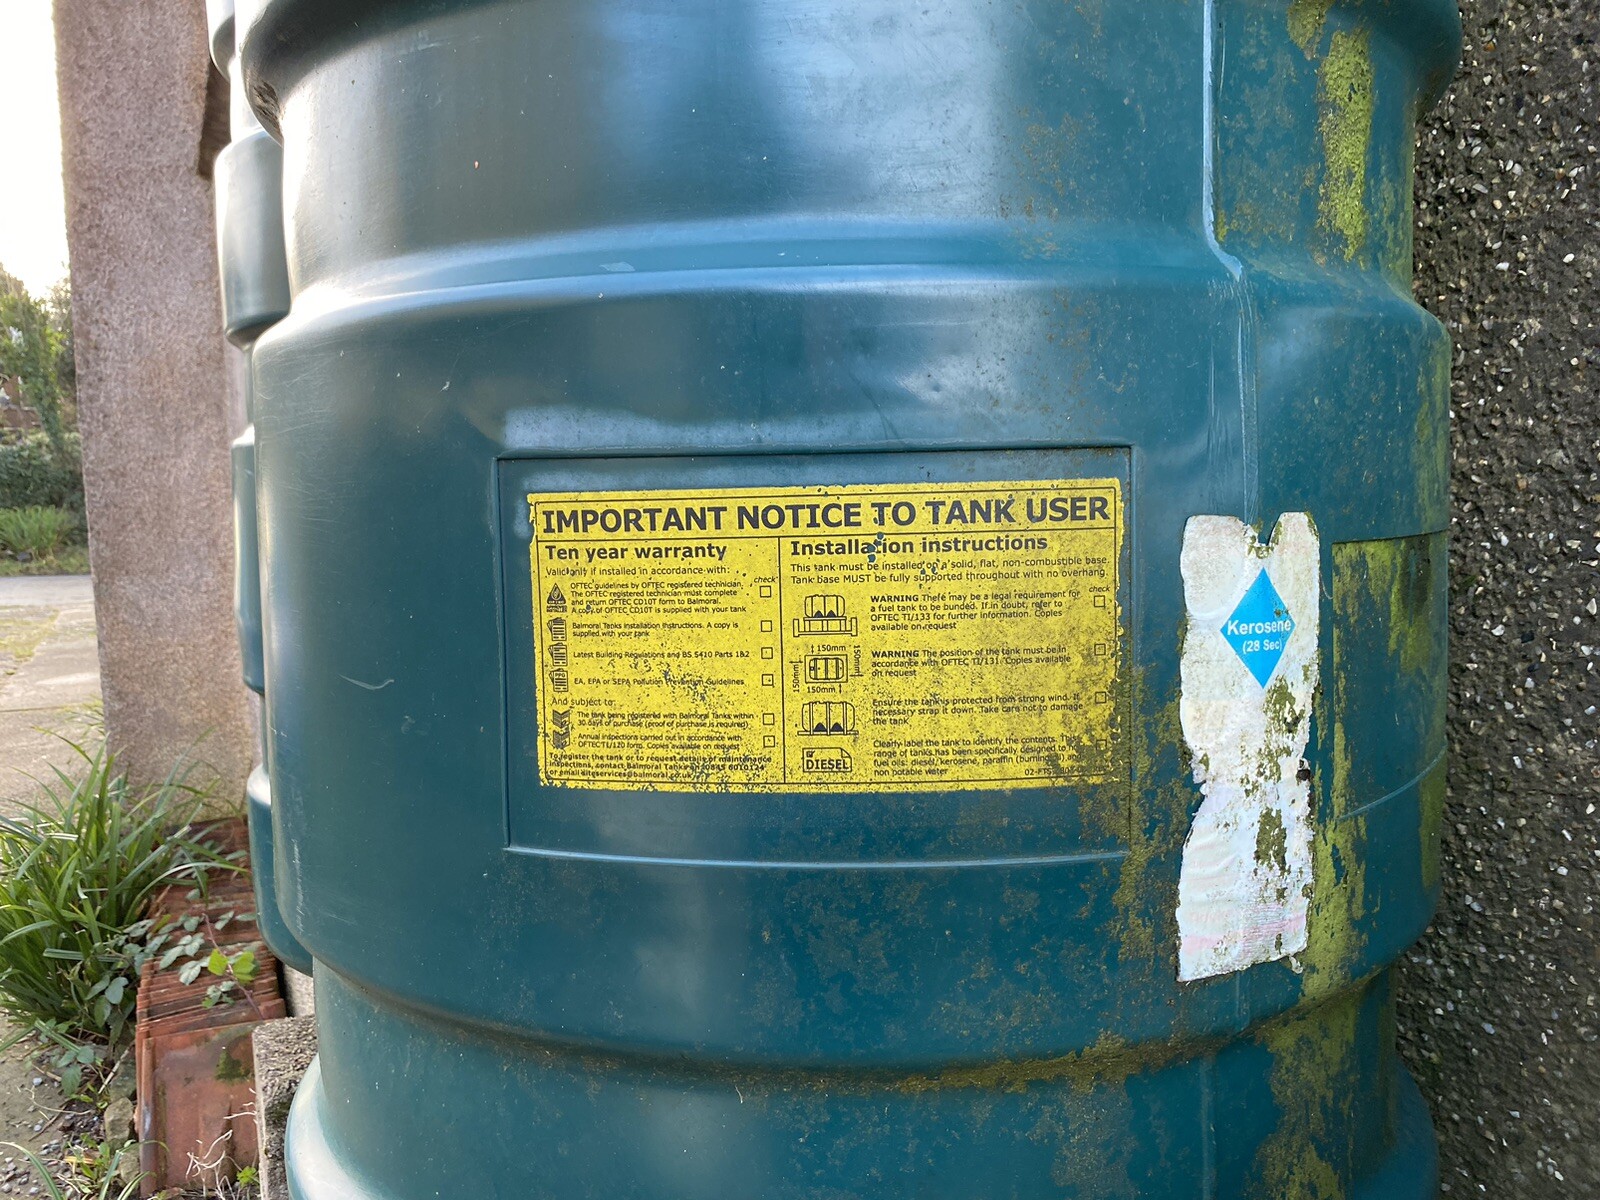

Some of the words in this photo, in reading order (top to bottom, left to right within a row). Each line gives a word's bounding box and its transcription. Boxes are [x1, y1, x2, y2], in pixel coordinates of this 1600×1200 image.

[543, 506, 727, 533] IMPORTANT
[737, 502, 862, 529] NOTICE
[871, 502, 916, 526] TO
[925, 498, 1016, 525] TANK
[1026, 496, 1110, 523] USER
[922, 537, 1048, 553] instructions
[545, 546, 579, 559] Ten
[586, 547, 628, 563] year
[635, 544, 727, 560] warranty
[882, 562, 922, 570] installed
[951, 560, 976, 569] solid,
[980, 560, 998, 568] flat,
[1003, 557, 1082, 567] non-combustible
[651, 566, 703, 574] accordance
[843, 574, 871, 582] MUST
[890, 574, 910, 583] fully
[914, 573, 962, 582] supported
[966, 572, 1020, 581] throughout
[1062, 569, 1108, 577] overhang.
[1015, 591, 1066, 600] requirement
[1002, 601, 1028, 610] doubt,
[870, 613, 899, 621] OFTEC
[948, 610, 977, 619] further
[1035, 609, 1062, 617] Copies
[925, 622, 956, 630] request
[1227, 619, 1291, 636] Kerosene
[1243, 640, 1260, 654] (28
[1263, 639, 1282, 651] Sec)
[940, 648, 972, 658] position
[570, 698, 602, 706] subject
[806, 759, 849, 770] DIESEL
